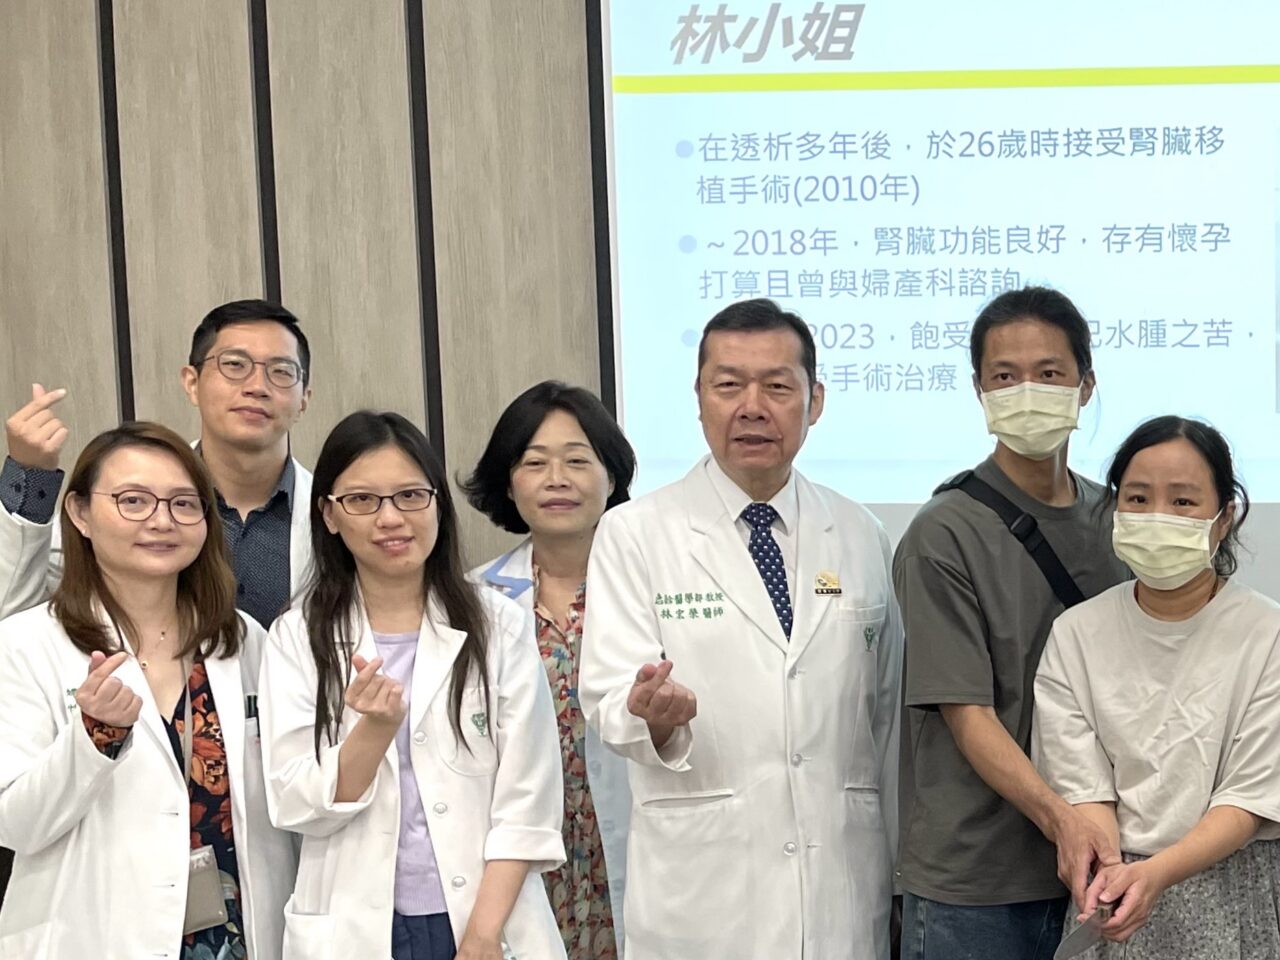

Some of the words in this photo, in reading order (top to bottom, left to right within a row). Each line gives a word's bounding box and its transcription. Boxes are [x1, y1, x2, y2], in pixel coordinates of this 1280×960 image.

[671, 2, 866, 65] 林小姐
[696, 173, 921, 207] 植手術(2010年)
[699, 267, 1020, 300] 打算且曾與婦產科諮詢
